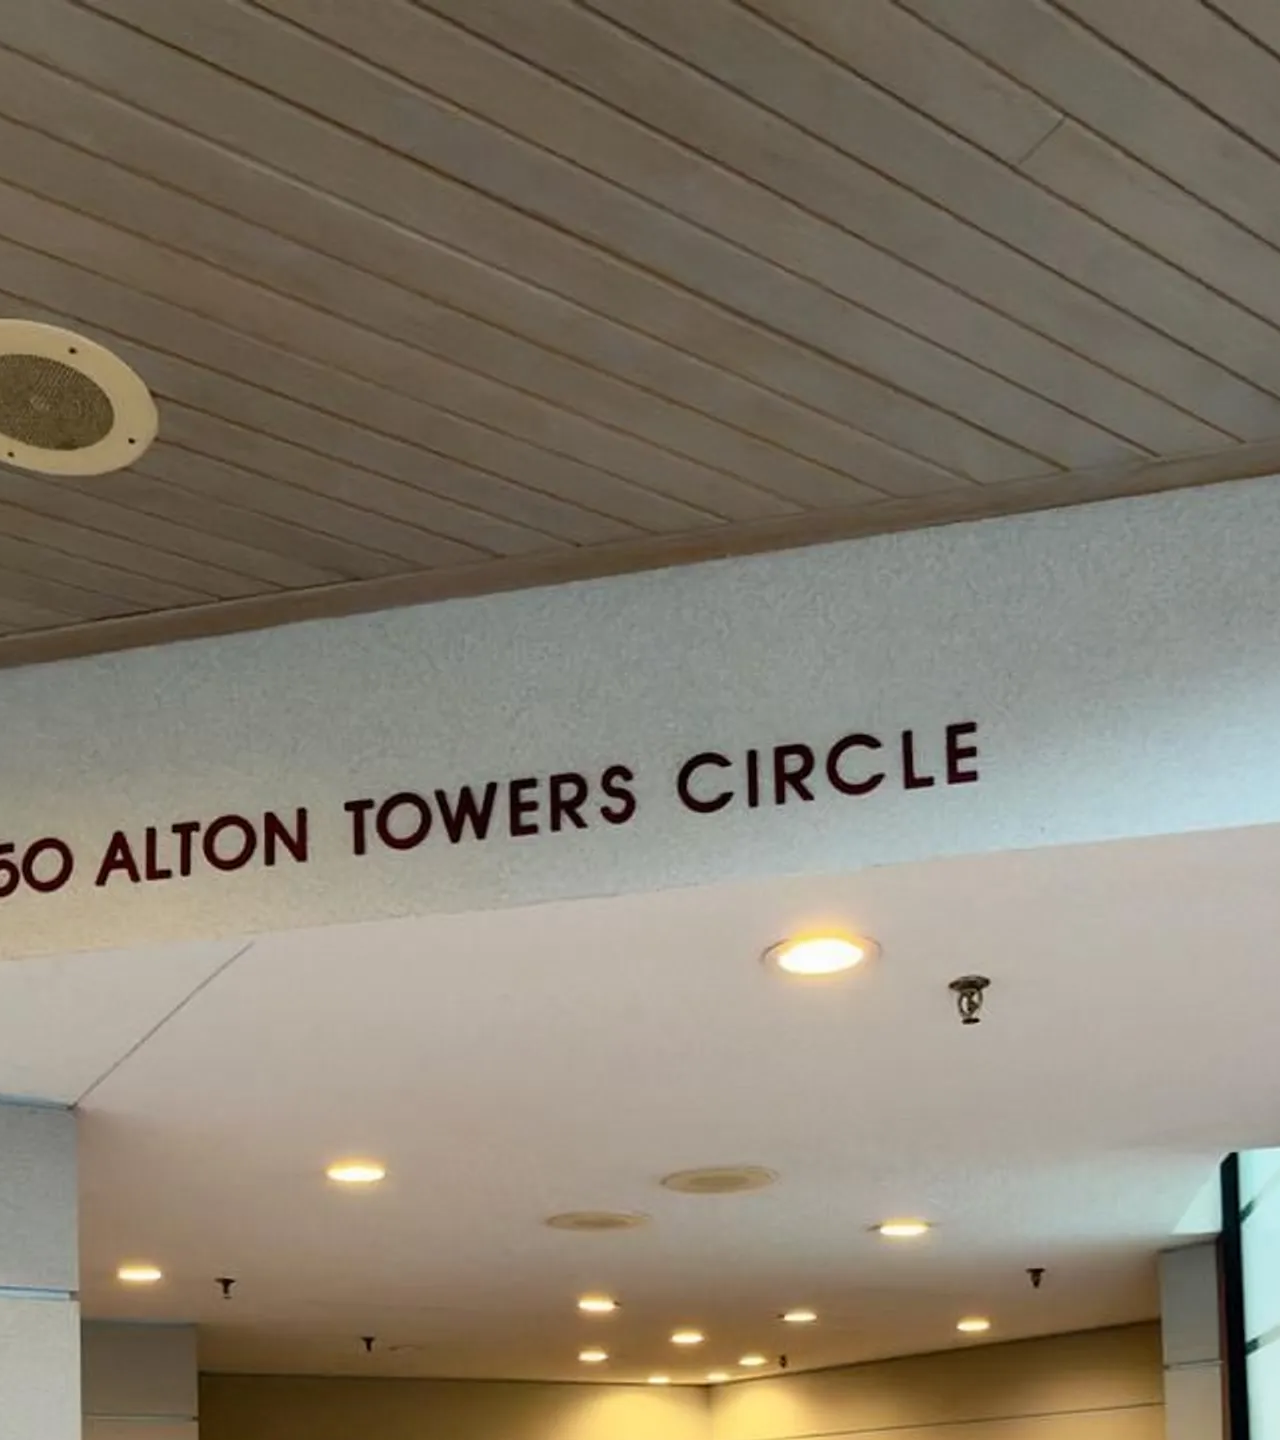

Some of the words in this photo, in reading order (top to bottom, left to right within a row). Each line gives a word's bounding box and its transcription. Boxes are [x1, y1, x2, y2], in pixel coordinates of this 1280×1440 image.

[94, 807, 310, 888] ALTON
[342, 763, 639, 857] TOWERS
[675, 720, 980, 815] CIRCLE
